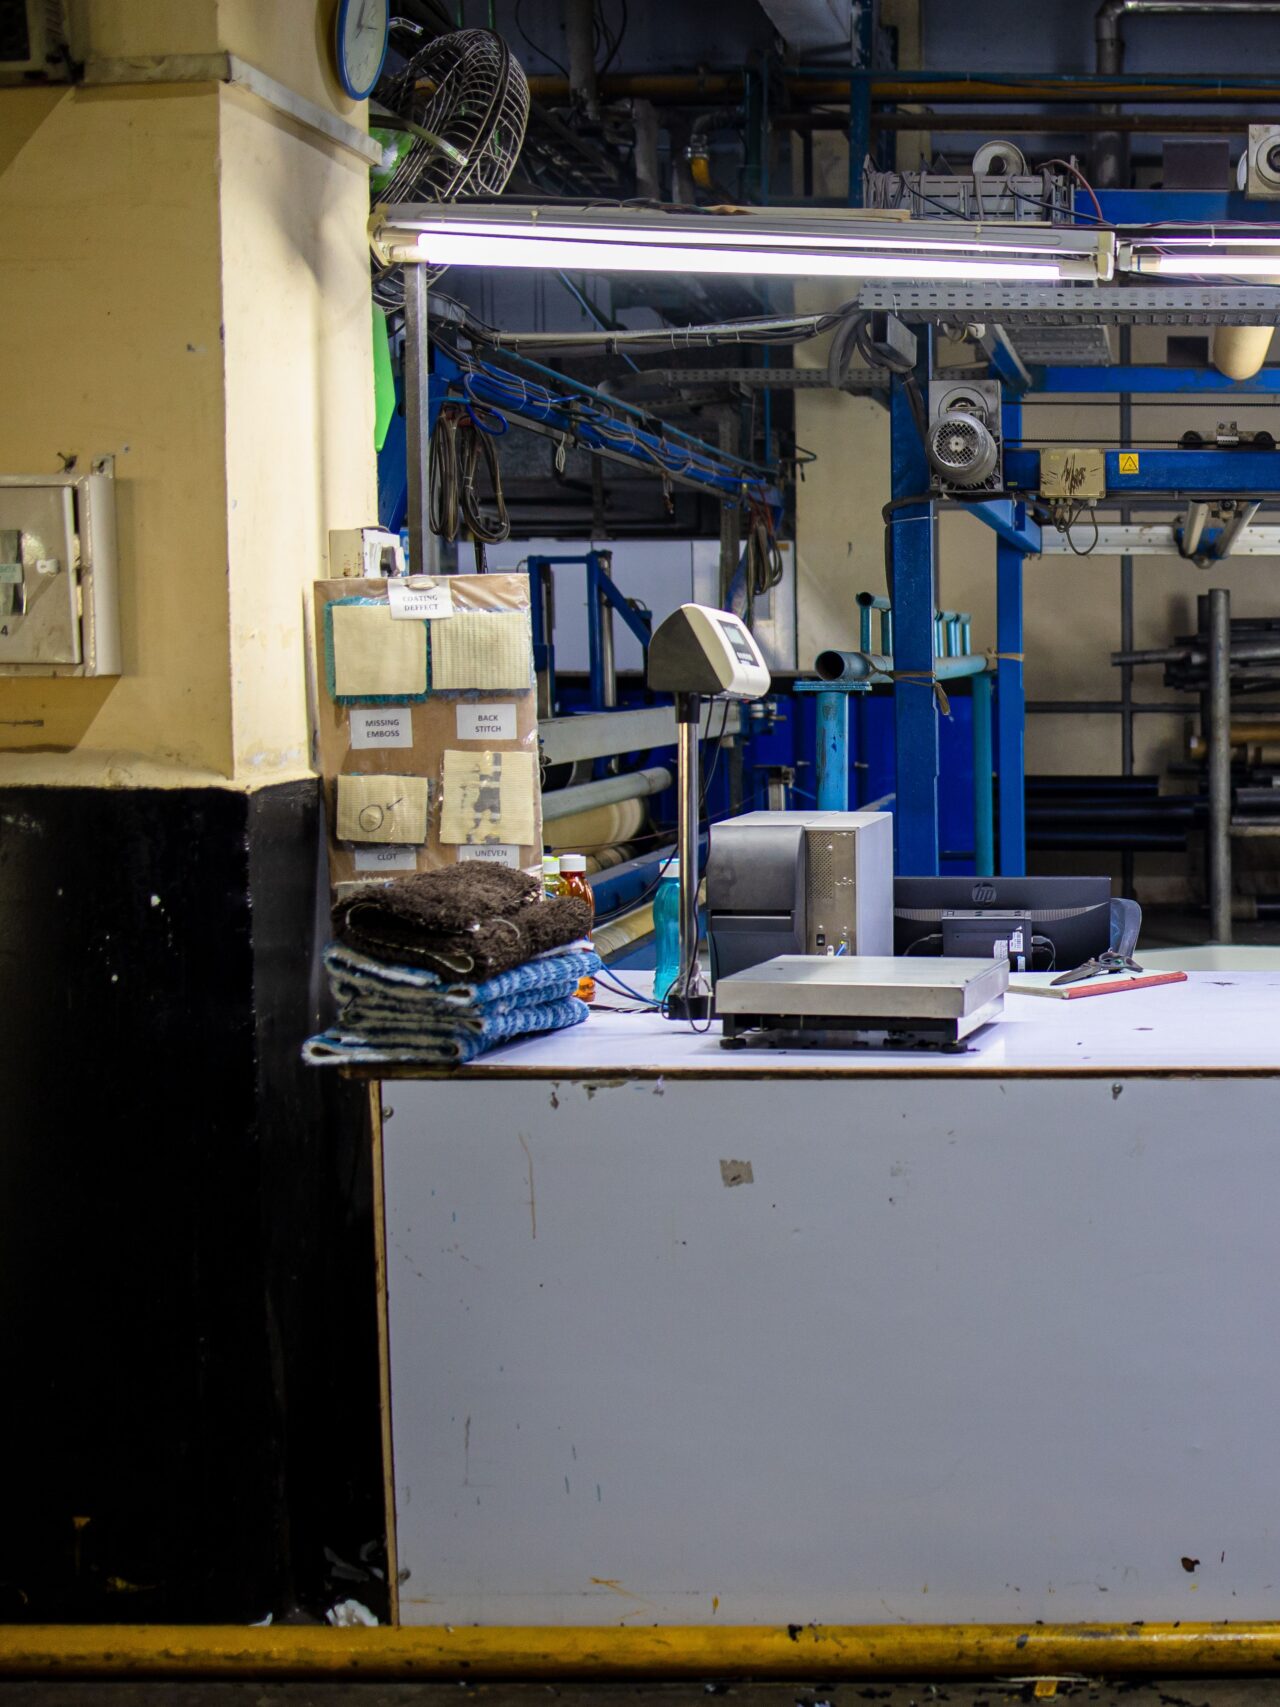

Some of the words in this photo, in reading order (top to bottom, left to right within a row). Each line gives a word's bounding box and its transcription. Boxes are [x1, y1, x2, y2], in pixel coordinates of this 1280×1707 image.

[402, 594, 438, 602] COATING
[477, 714, 499, 722] BACK
[365, 719, 400, 727] MISSING
[475, 725, 502, 733] STITCH
[366, 730, 400, 738] EMBOSS
[377, 852, 397, 861] CLOT
[474, 849, 508, 857] UNEVEN
[973, 882, 996, 907] hp
